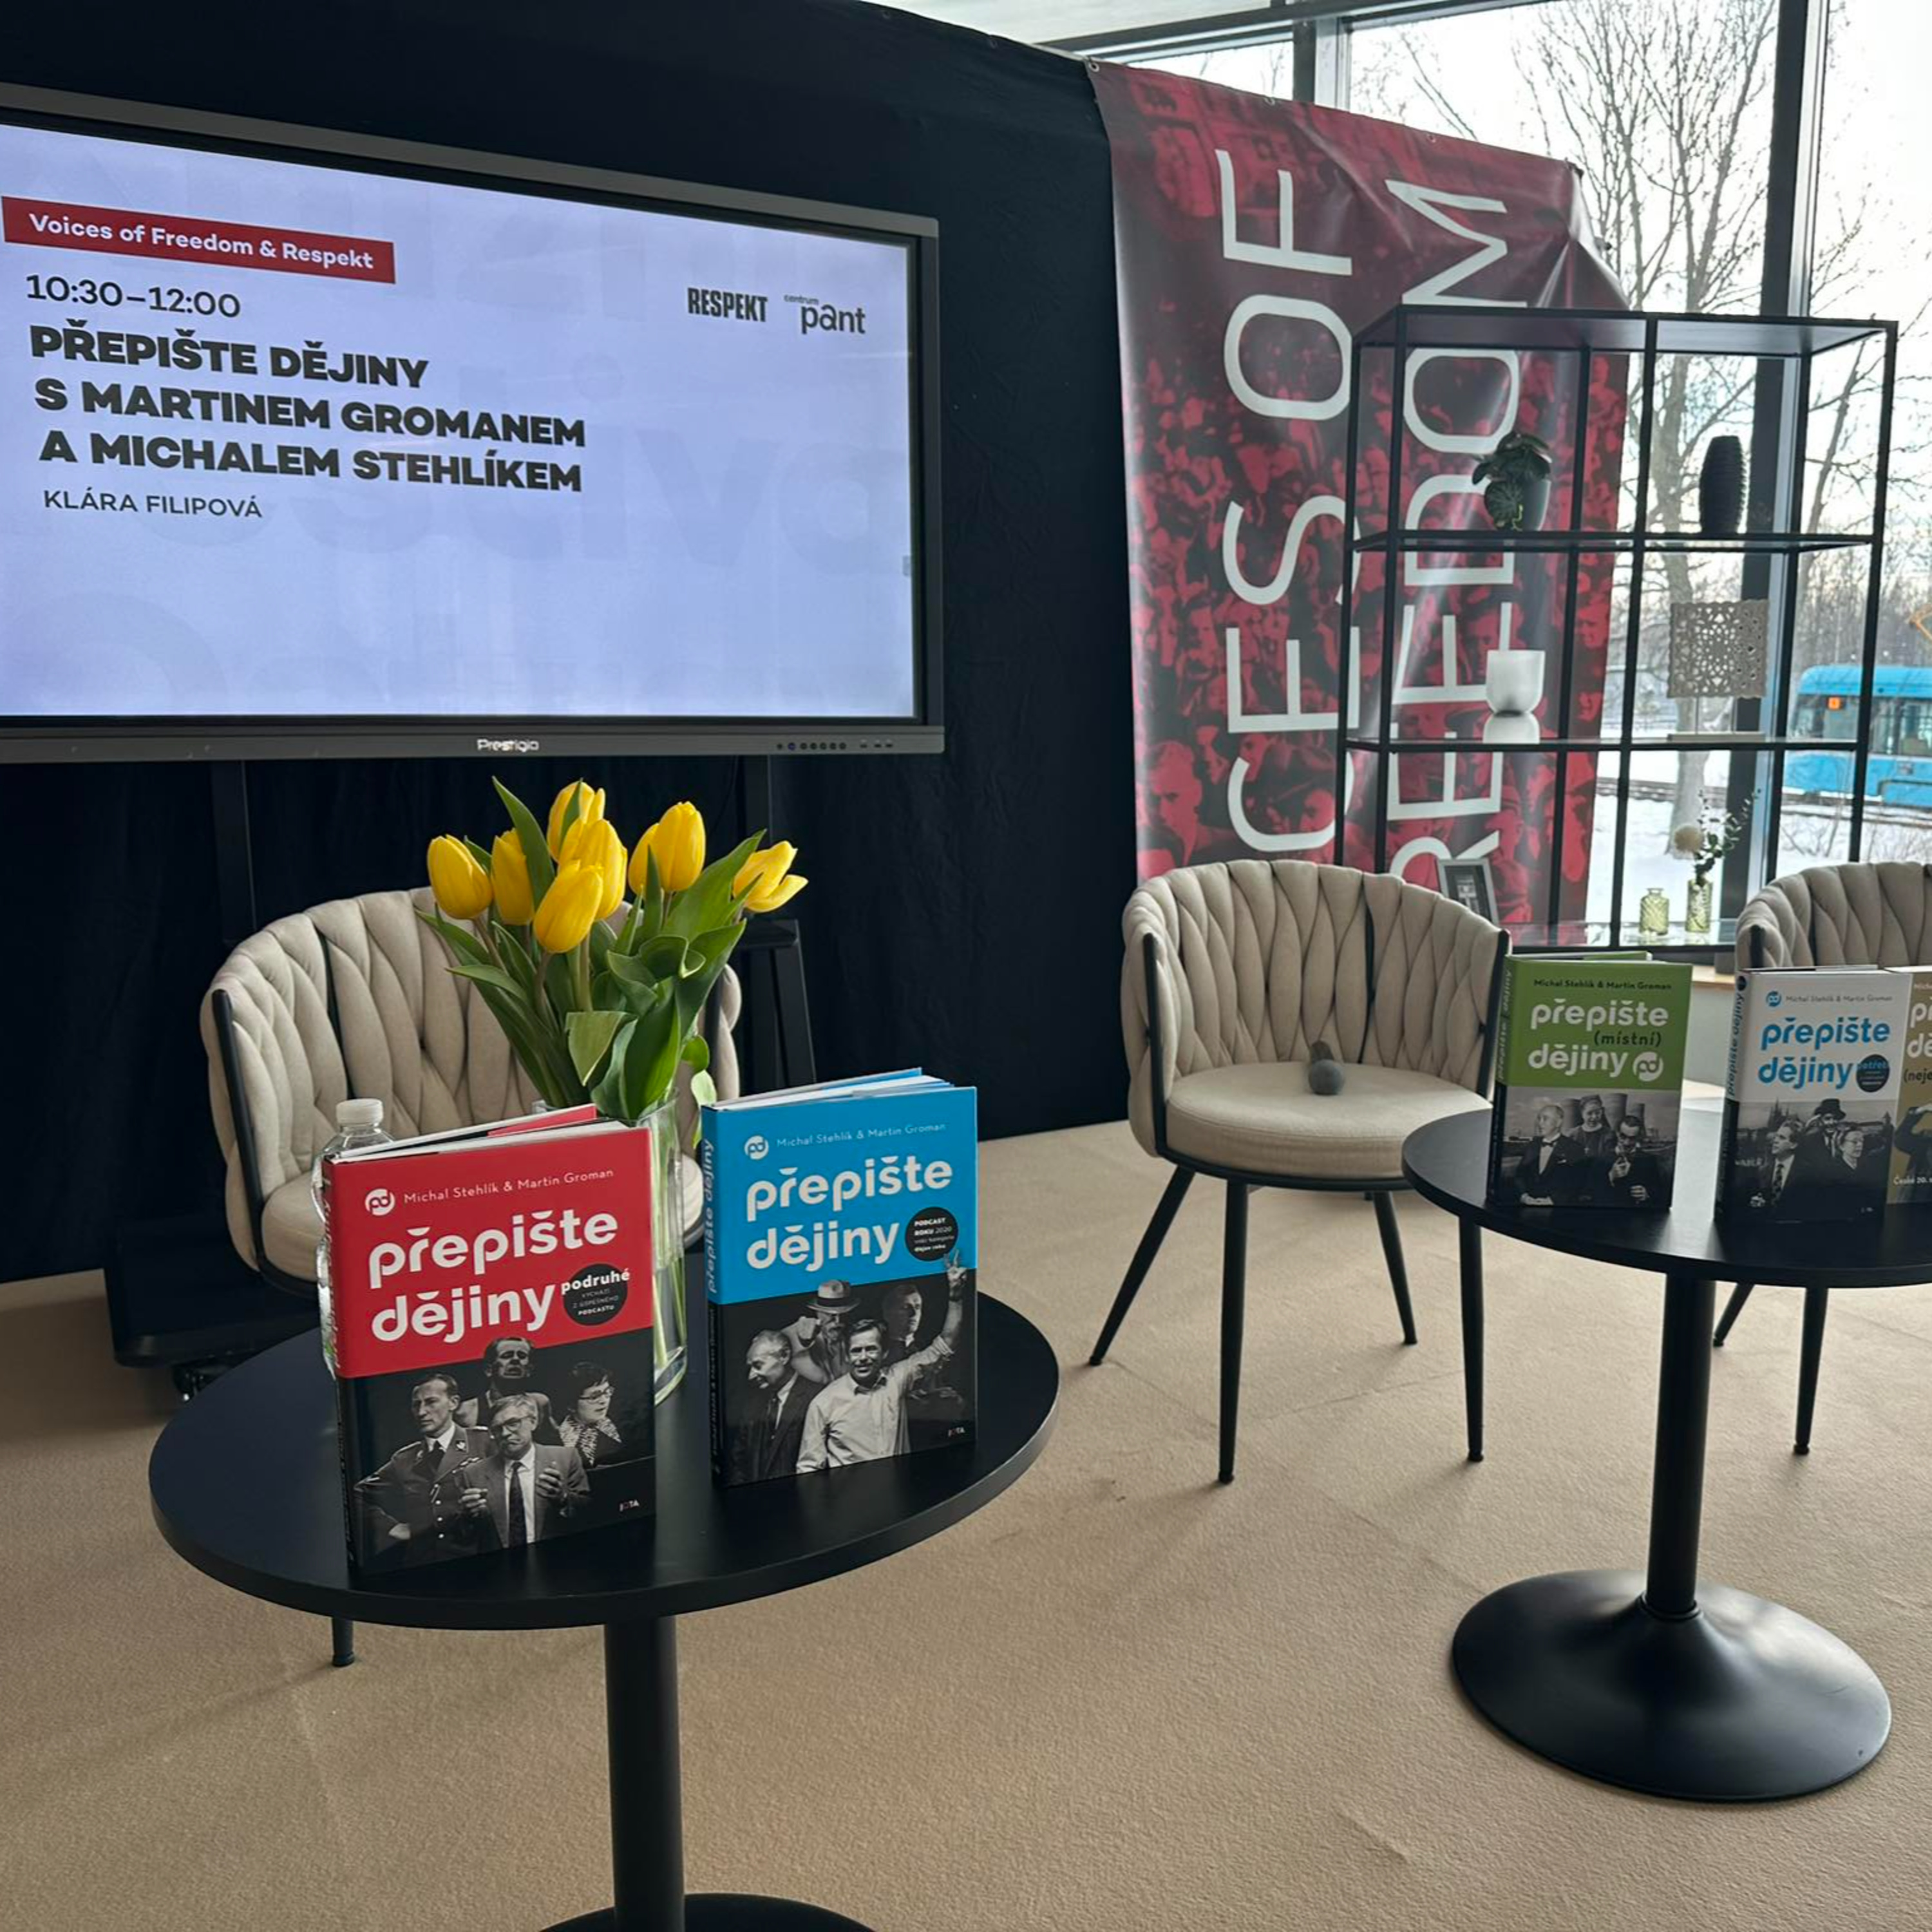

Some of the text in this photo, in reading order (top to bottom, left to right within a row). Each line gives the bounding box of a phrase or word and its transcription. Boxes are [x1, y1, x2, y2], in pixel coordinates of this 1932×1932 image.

[29, 213, 374, 269] Voices of Freedom & Respekt
[783, 294, 819, 305] centrum
[1215, 149, 1352, 421] OF
[687, 287, 768, 322] RESPEKT
[30, 318, 429, 388] PŘEPIŠTE DĚJINY
[34, 377, 585, 448] S MARTINEM GROMANEM
[39, 430, 582, 492] A MICHALEM STEHLÍKEM
[44, 486, 263, 518] KLÁRA FILIPOVÁ
[1530, 998, 1669, 1031] přepište
[1594, 1031, 1662, 1047] (místní)
[1761, 1016, 1890, 1050] přepište
[1528, 1043, 1629, 1077] dějiny
[1758, 1056, 1853, 1090] dějiny
[776, 1136, 813, 1148] Michal
[856, 1130, 864, 1139] &
[867, 1127, 902, 1137] Martin
[905, 1123, 946, 1134] Groman
[403, 1169, 614, 1204] Michal Stehlík & Martin Groman
[746, 1154, 953, 1222] přepište
[368, 1208, 618, 1289] přepište
[746, 1221, 900, 1272] dějiny
[561, 1267, 630, 1296] podruhé
[371, 1283, 556, 1343] dějiny
